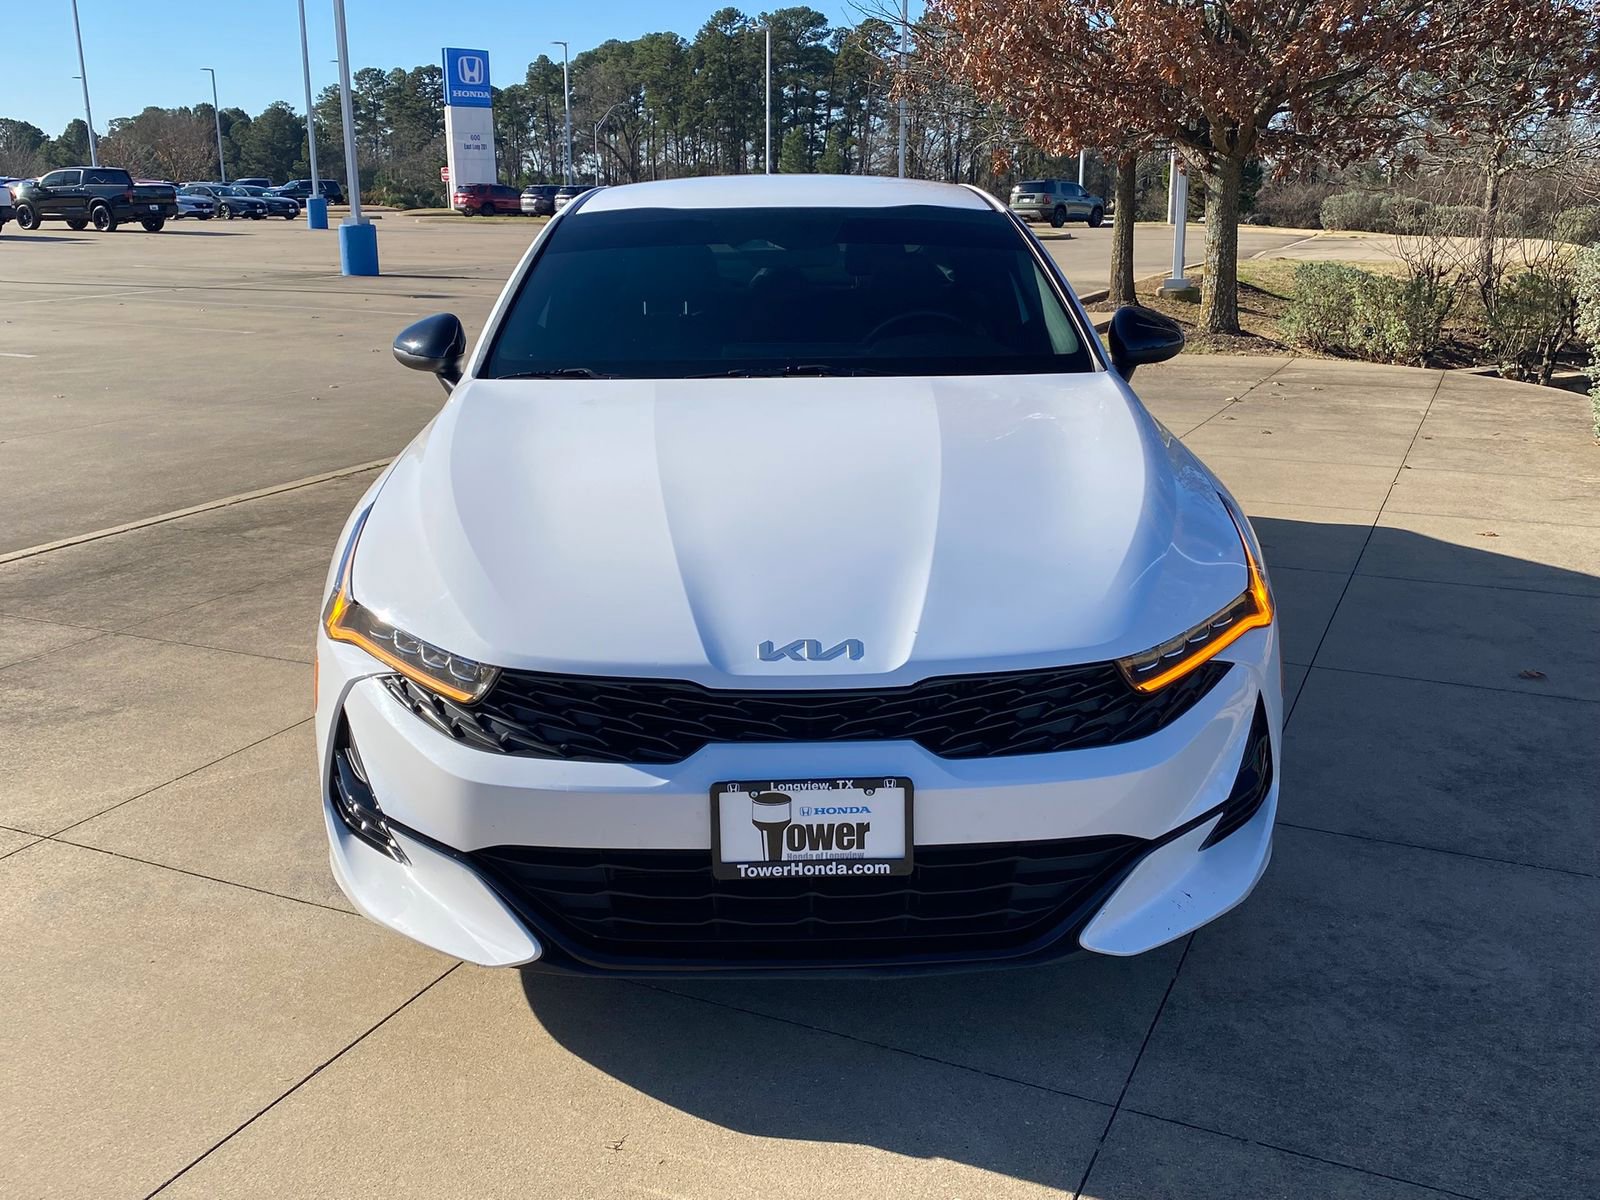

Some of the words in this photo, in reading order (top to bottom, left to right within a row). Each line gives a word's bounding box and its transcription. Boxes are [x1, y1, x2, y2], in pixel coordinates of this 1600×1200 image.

[452, 90, 490, 98] HONDA
[770, 780, 833, 792] Longview,
[837, 780, 854, 790] TX
[814, 806, 871, 815] HONDA
[787, 852, 814, 860] Honda
[816, 852, 824, 860] of
[737, 861, 890, 878] TowerHonda.com
